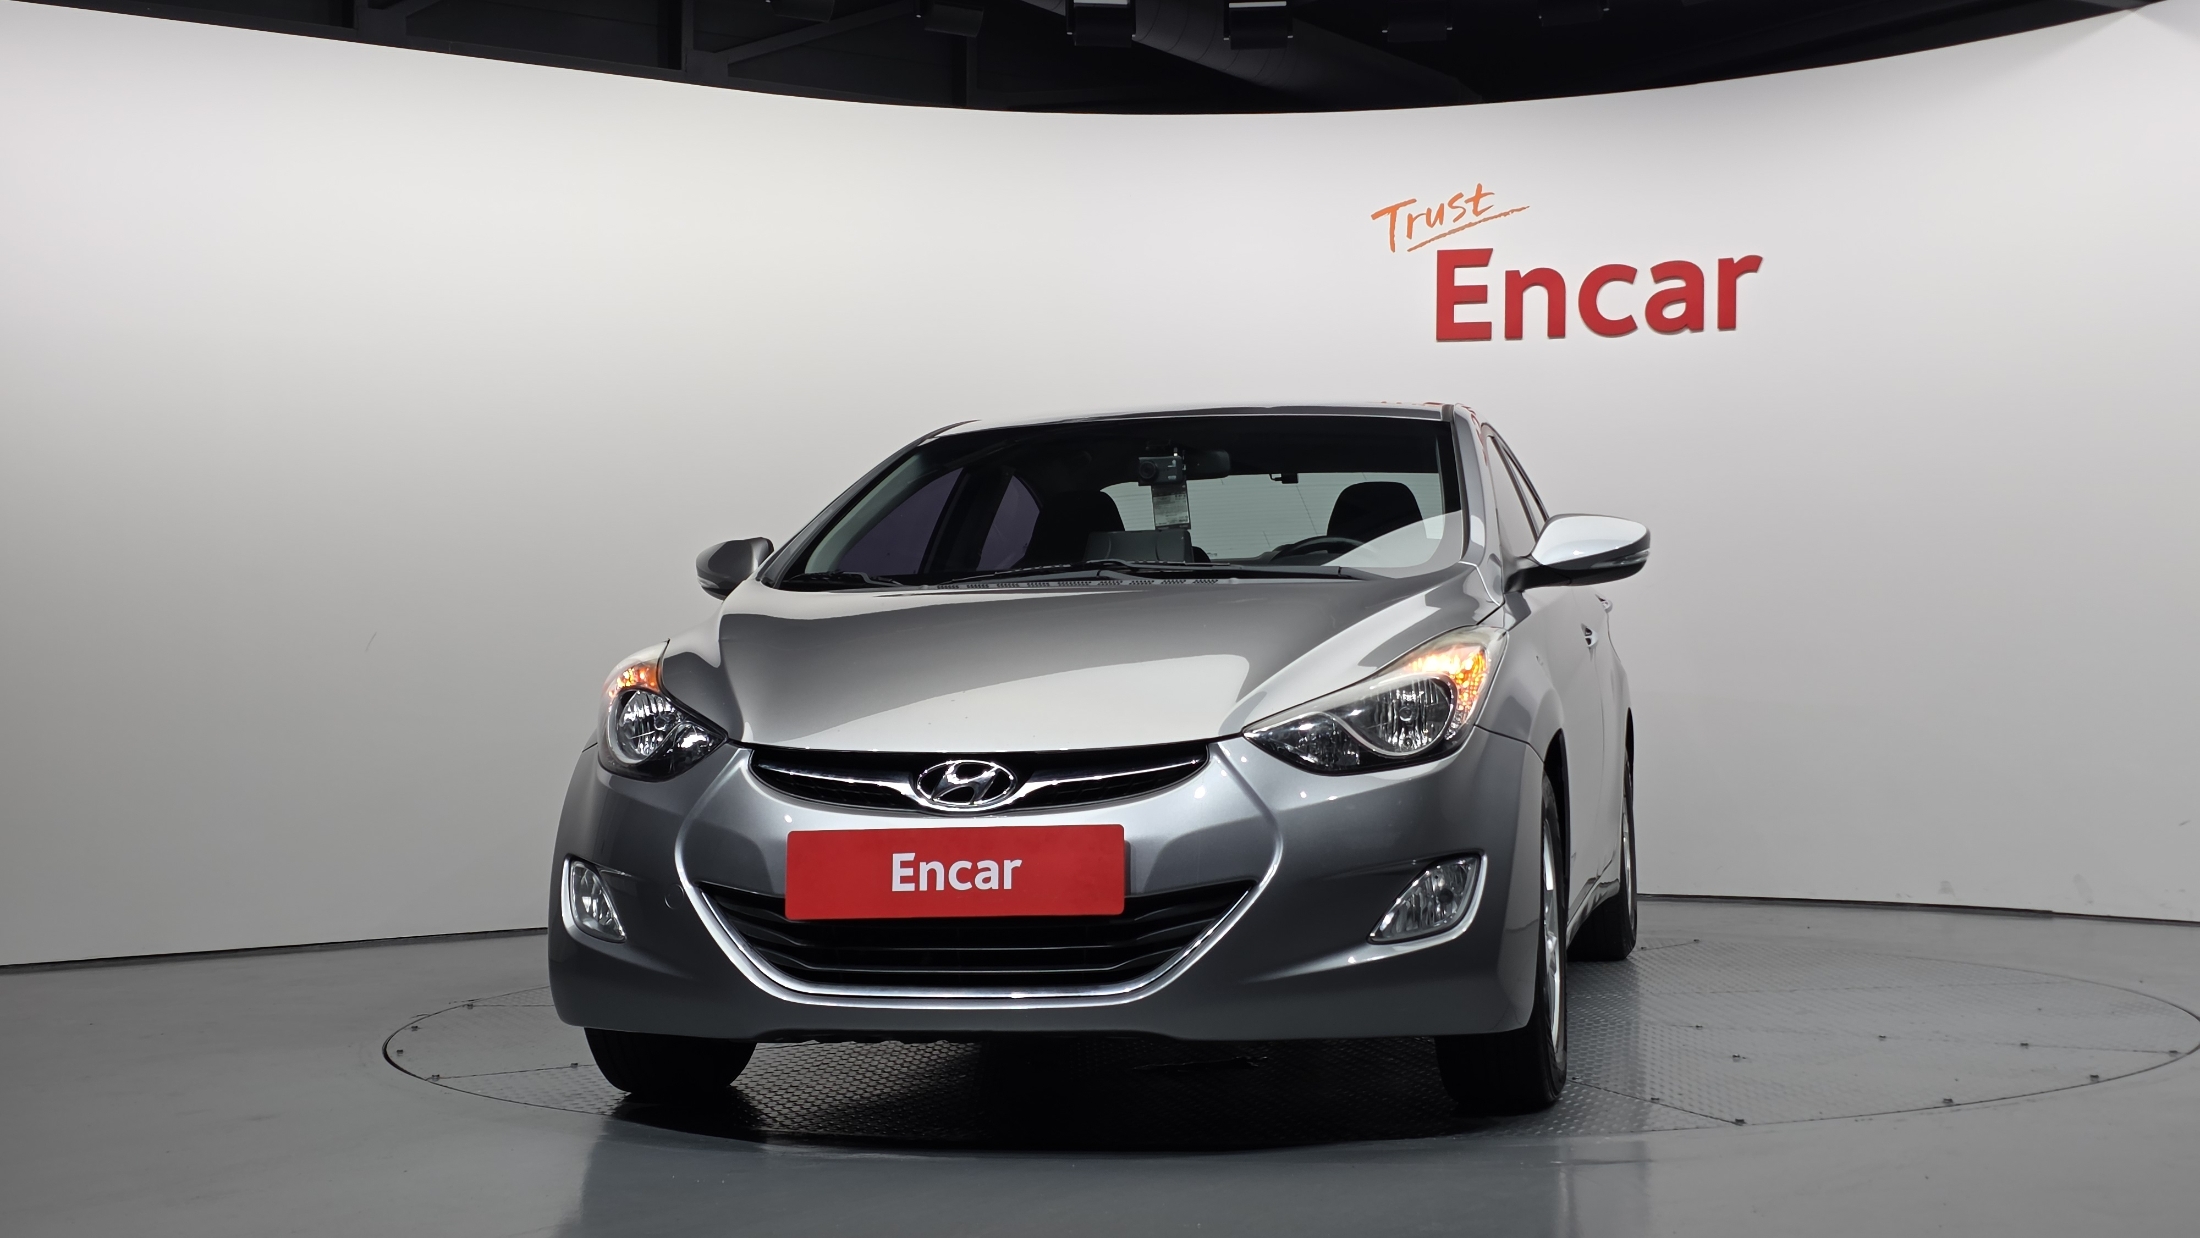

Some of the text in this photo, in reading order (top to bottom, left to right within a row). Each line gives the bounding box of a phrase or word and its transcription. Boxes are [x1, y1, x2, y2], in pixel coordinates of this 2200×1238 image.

[1371, 183, 1495, 252] Trust
[1436, 248, 1762, 341] Encar
[891, 853, 1022, 892] Encar
